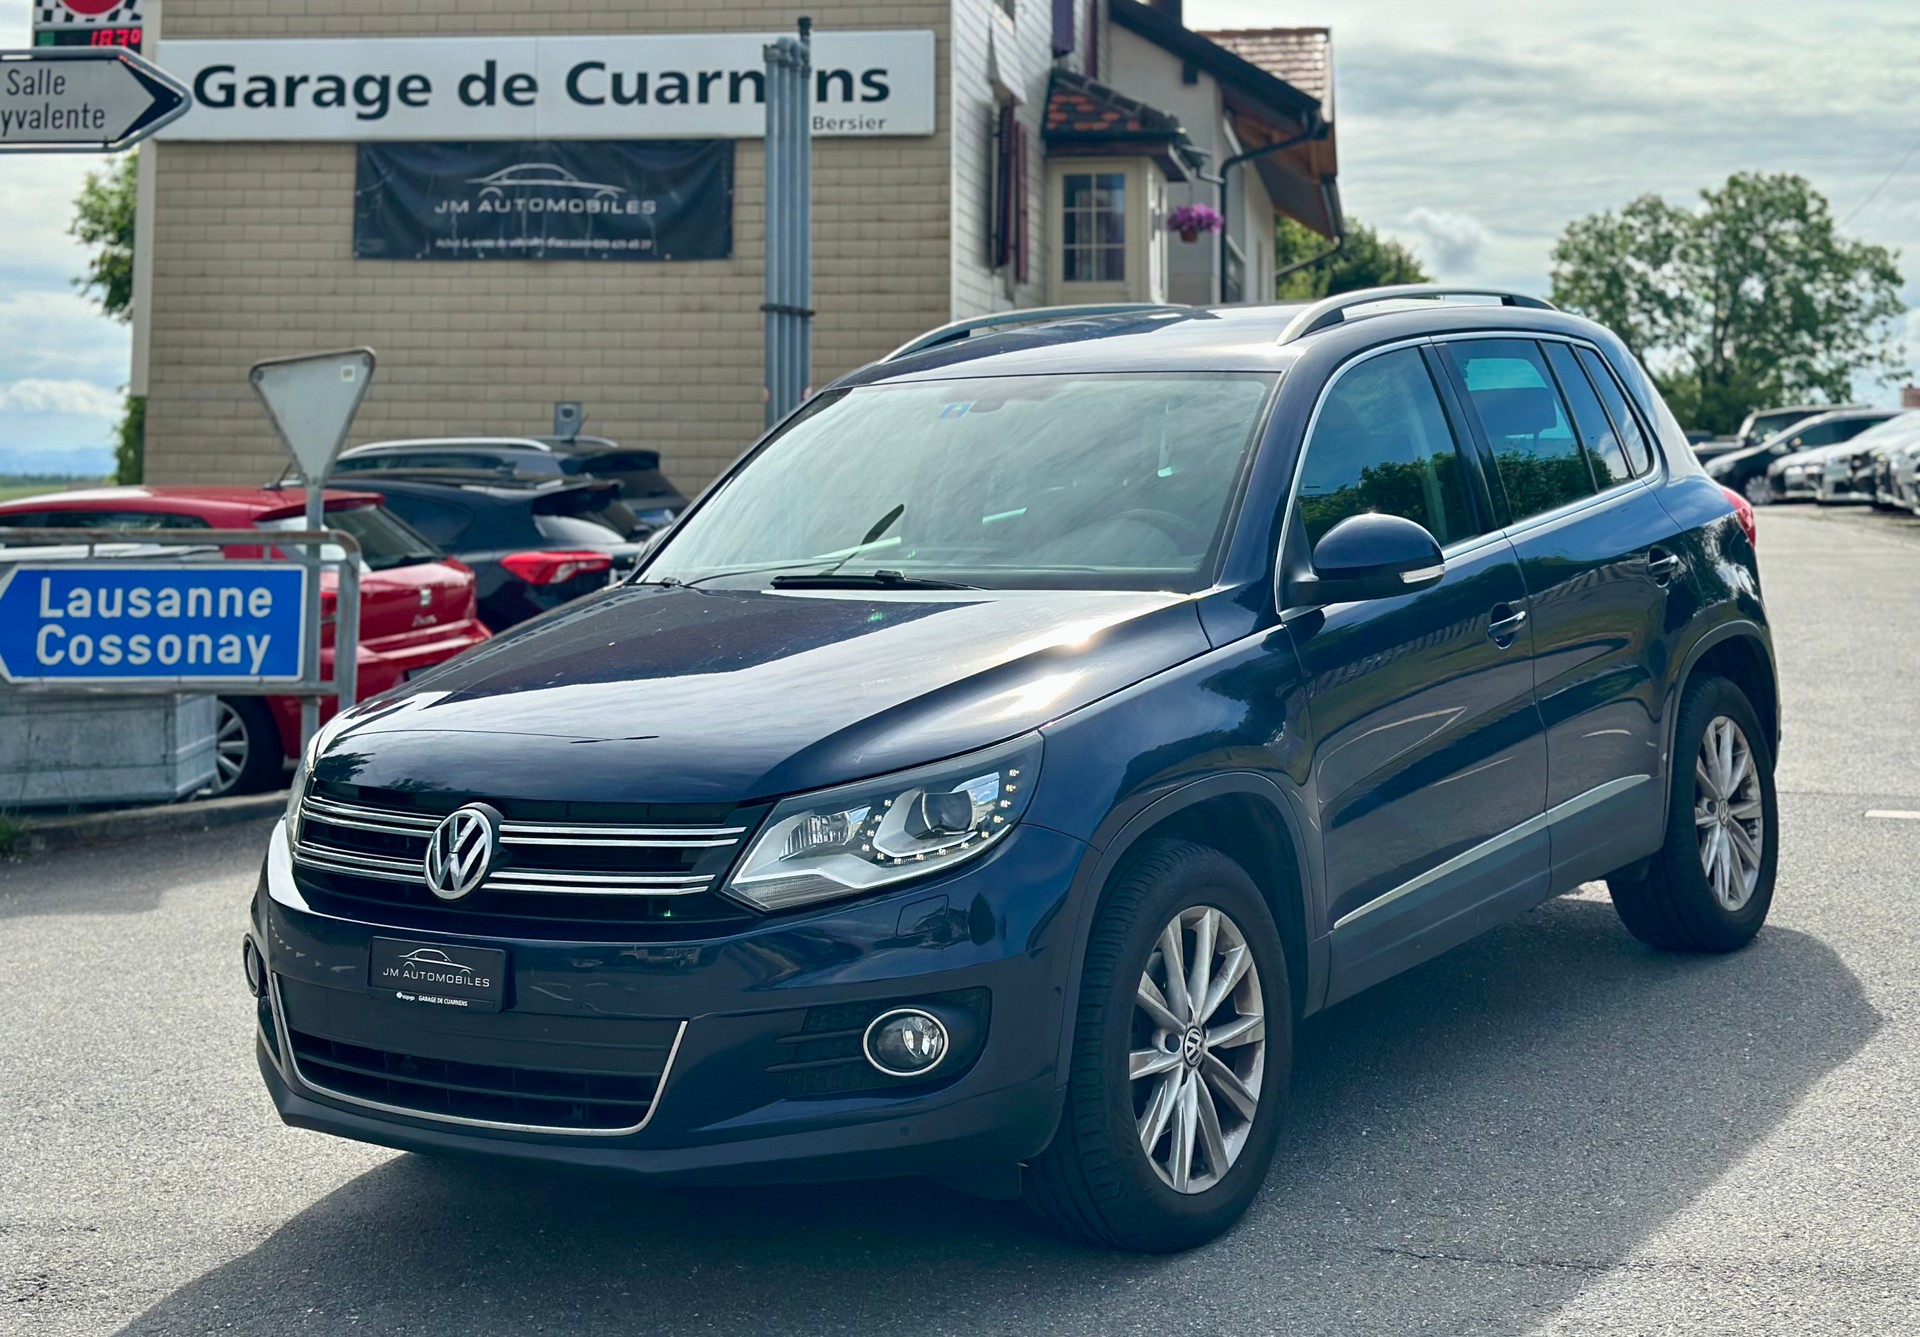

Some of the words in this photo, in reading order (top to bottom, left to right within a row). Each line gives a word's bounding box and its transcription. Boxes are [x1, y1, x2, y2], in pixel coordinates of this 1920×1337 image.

[6, 69, 65, 96] Salle
[193, 64, 433, 121] Garage
[457, 60, 539, 107] de
[565, 61, 890, 106] Cuarnns
[1, 102, 105, 137] yvalente
[812, 114, 886, 131] Bersier
[434, 200, 469, 214] JM
[477, 198, 657, 215] AUTOMOBILES
[39, 576, 273, 618] Lausanne
[36, 623, 272, 675] Cossonay
[382, 967, 399, 977] JM
[403, 970, 490, 988] AUTOMOBILES
